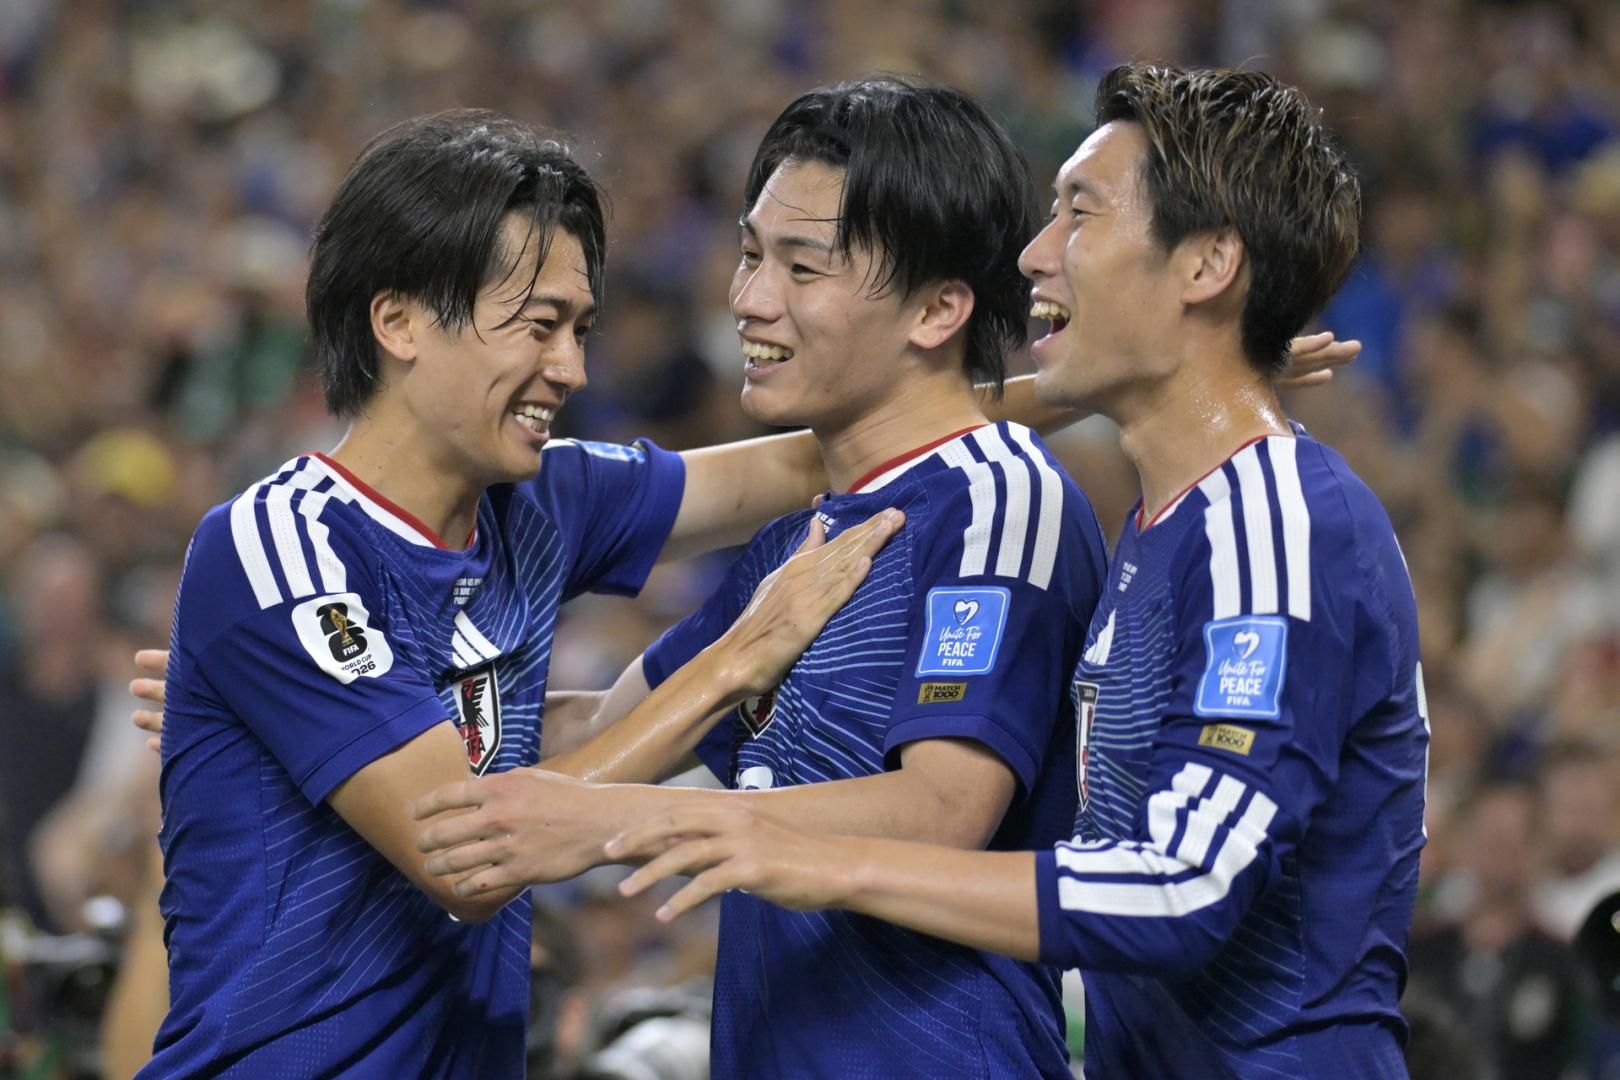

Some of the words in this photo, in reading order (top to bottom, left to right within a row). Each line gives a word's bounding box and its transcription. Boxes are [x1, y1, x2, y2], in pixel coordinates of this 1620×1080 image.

[939, 626, 965, 642] Unite
[966, 626, 982, 641] For
[342, 644, 360, 657] FIFA
[937, 642, 976, 656] PEACE
[361, 654, 373, 663] CUP
[942, 658, 964, 667] FIFA
[1219, 658, 1247, 676] Unite
[1248, 659, 1266, 676] For
[1219, 677, 1262, 695] PEACE
[1226, 696, 1251, 706] FIFA
